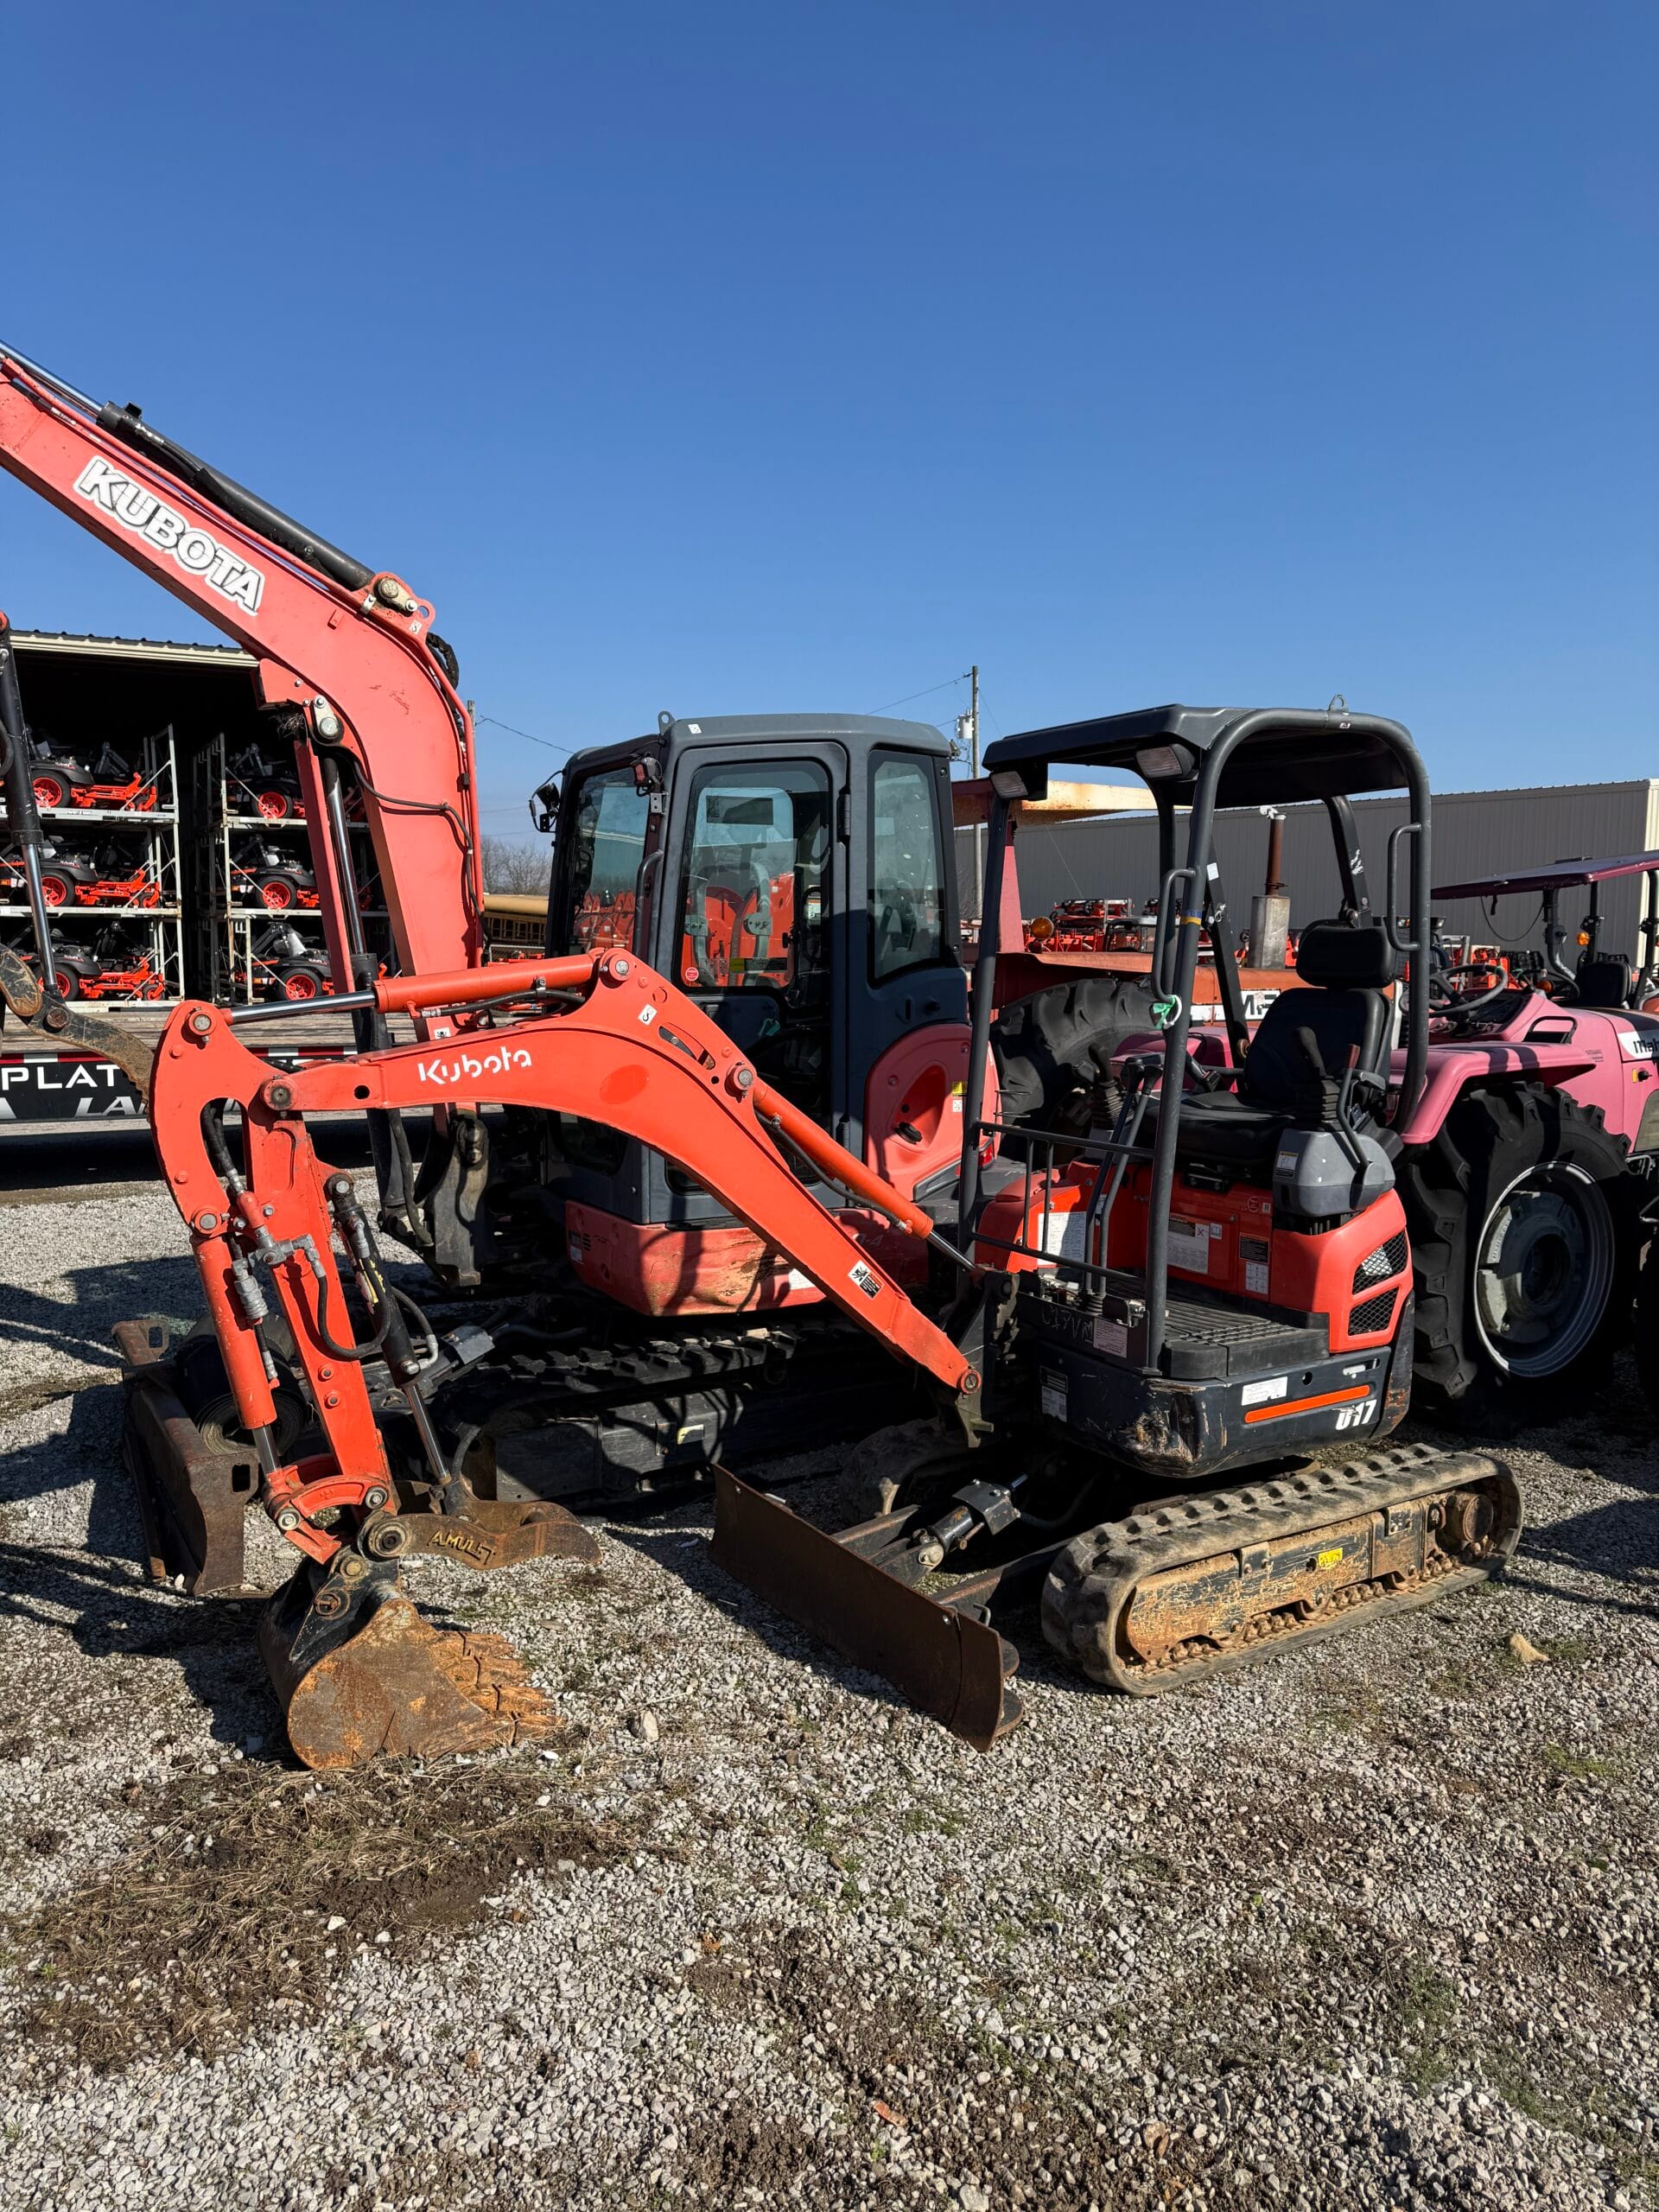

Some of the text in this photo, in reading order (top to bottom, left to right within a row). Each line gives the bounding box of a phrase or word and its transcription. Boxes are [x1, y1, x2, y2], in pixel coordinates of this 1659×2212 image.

[73, 455, 265, 616] KUBOTA
[417, 1046, 532, 1085] Kubota
[73, 1096, 146, 1118] LA
[1335, 1398, 1377, 1431] U17
